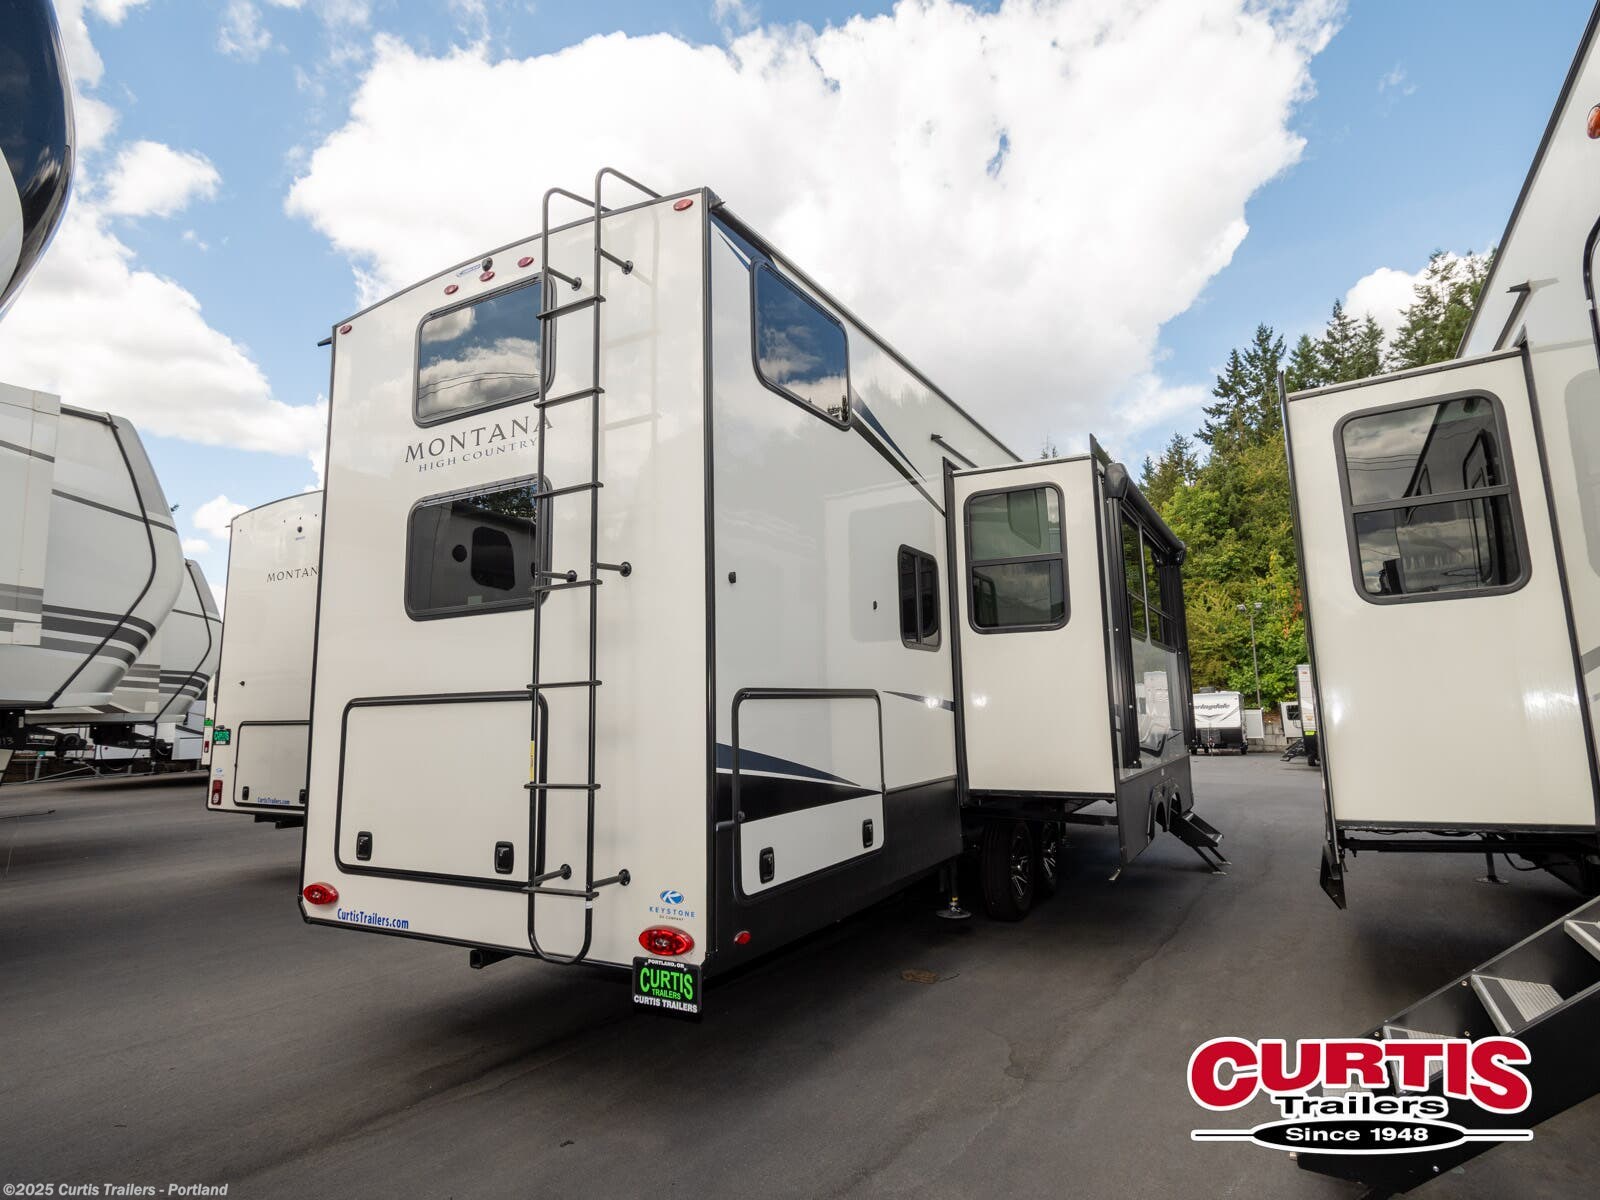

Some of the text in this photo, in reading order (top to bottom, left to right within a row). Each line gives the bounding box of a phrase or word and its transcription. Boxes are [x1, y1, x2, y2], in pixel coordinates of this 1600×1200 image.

[405, 416, 553, 463] MONTANA
[418, 437, 538, 473] HIGH COUNTRY
[337, 908, 409, 929] CurtisTrailers.com
[649, 906, 696, 918] KEYSTONE
[640, 967, 694, 1000] CURTIS
[652, 988, 682, 1000] TRAILERS
[633, 994, 698, 1014] CURTIS TRAILERS
